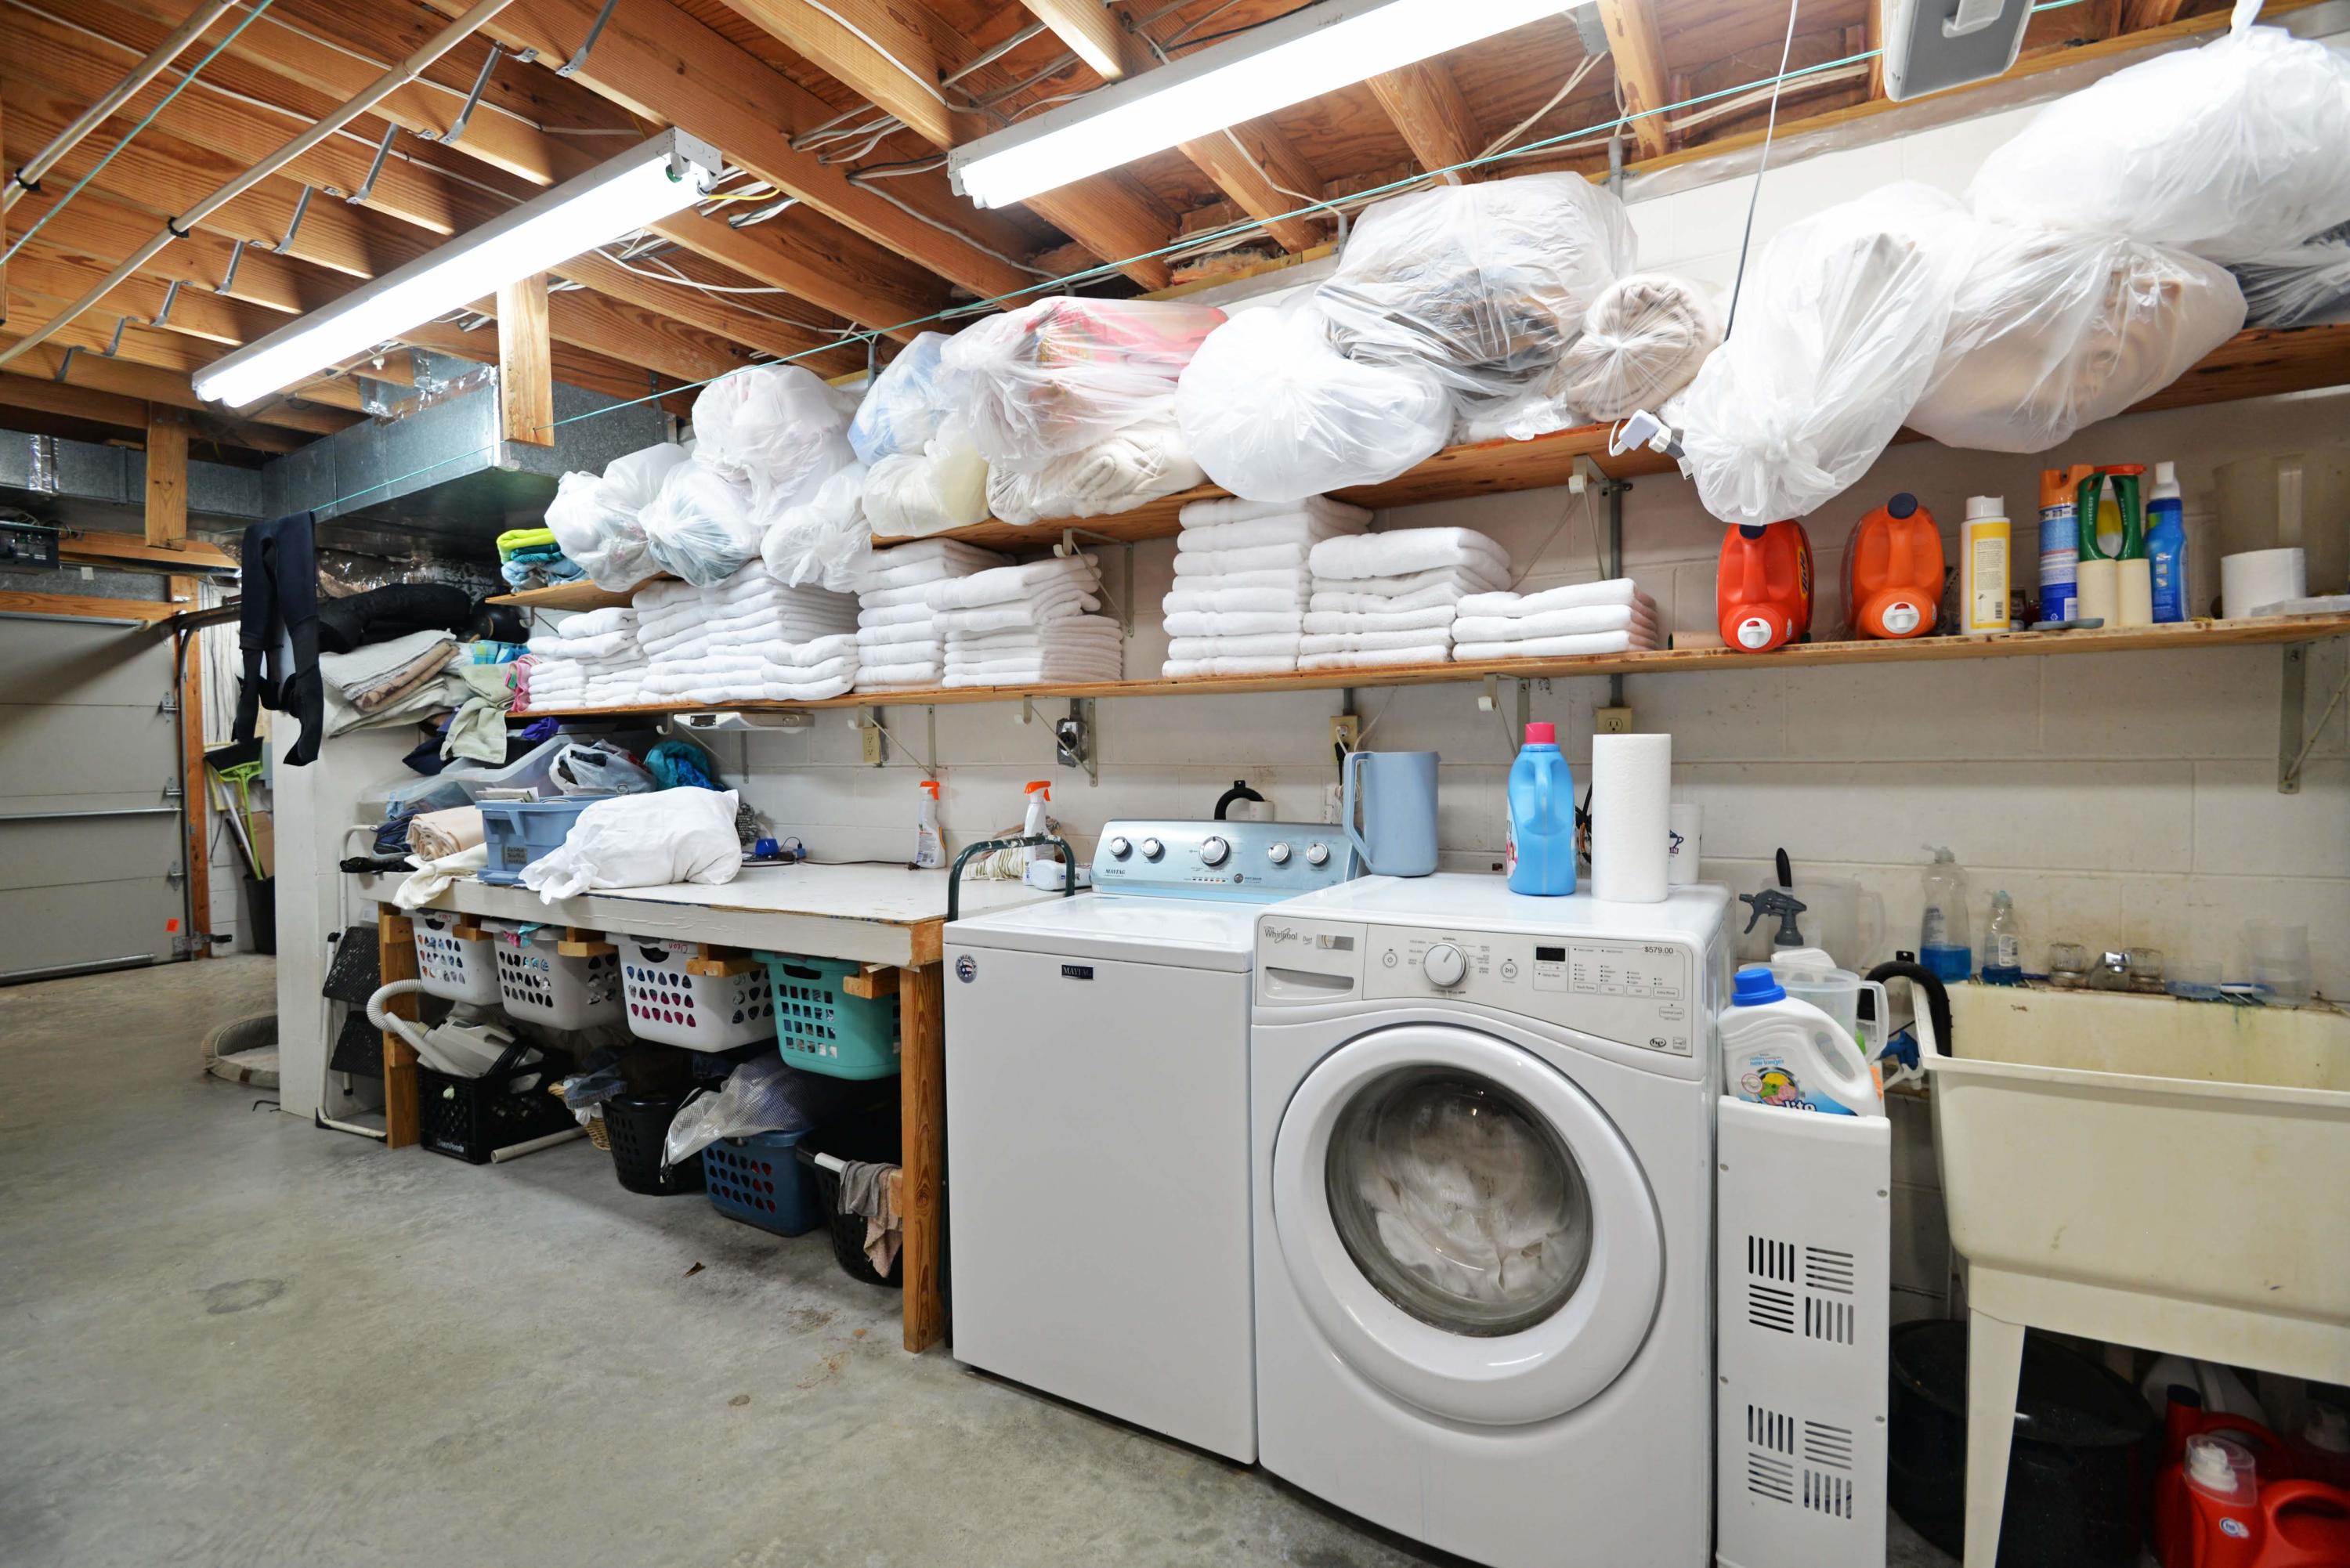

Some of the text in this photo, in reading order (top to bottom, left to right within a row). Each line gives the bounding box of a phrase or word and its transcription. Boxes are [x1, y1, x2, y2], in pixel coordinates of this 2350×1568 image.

[1264, 928, 1298, 942] Whirlpool
[1643, 945, 1674, 955] $579.00
[957, 953, 977, 970] AMERICA
[1063, 966, 1092, 977] MAYTAG
